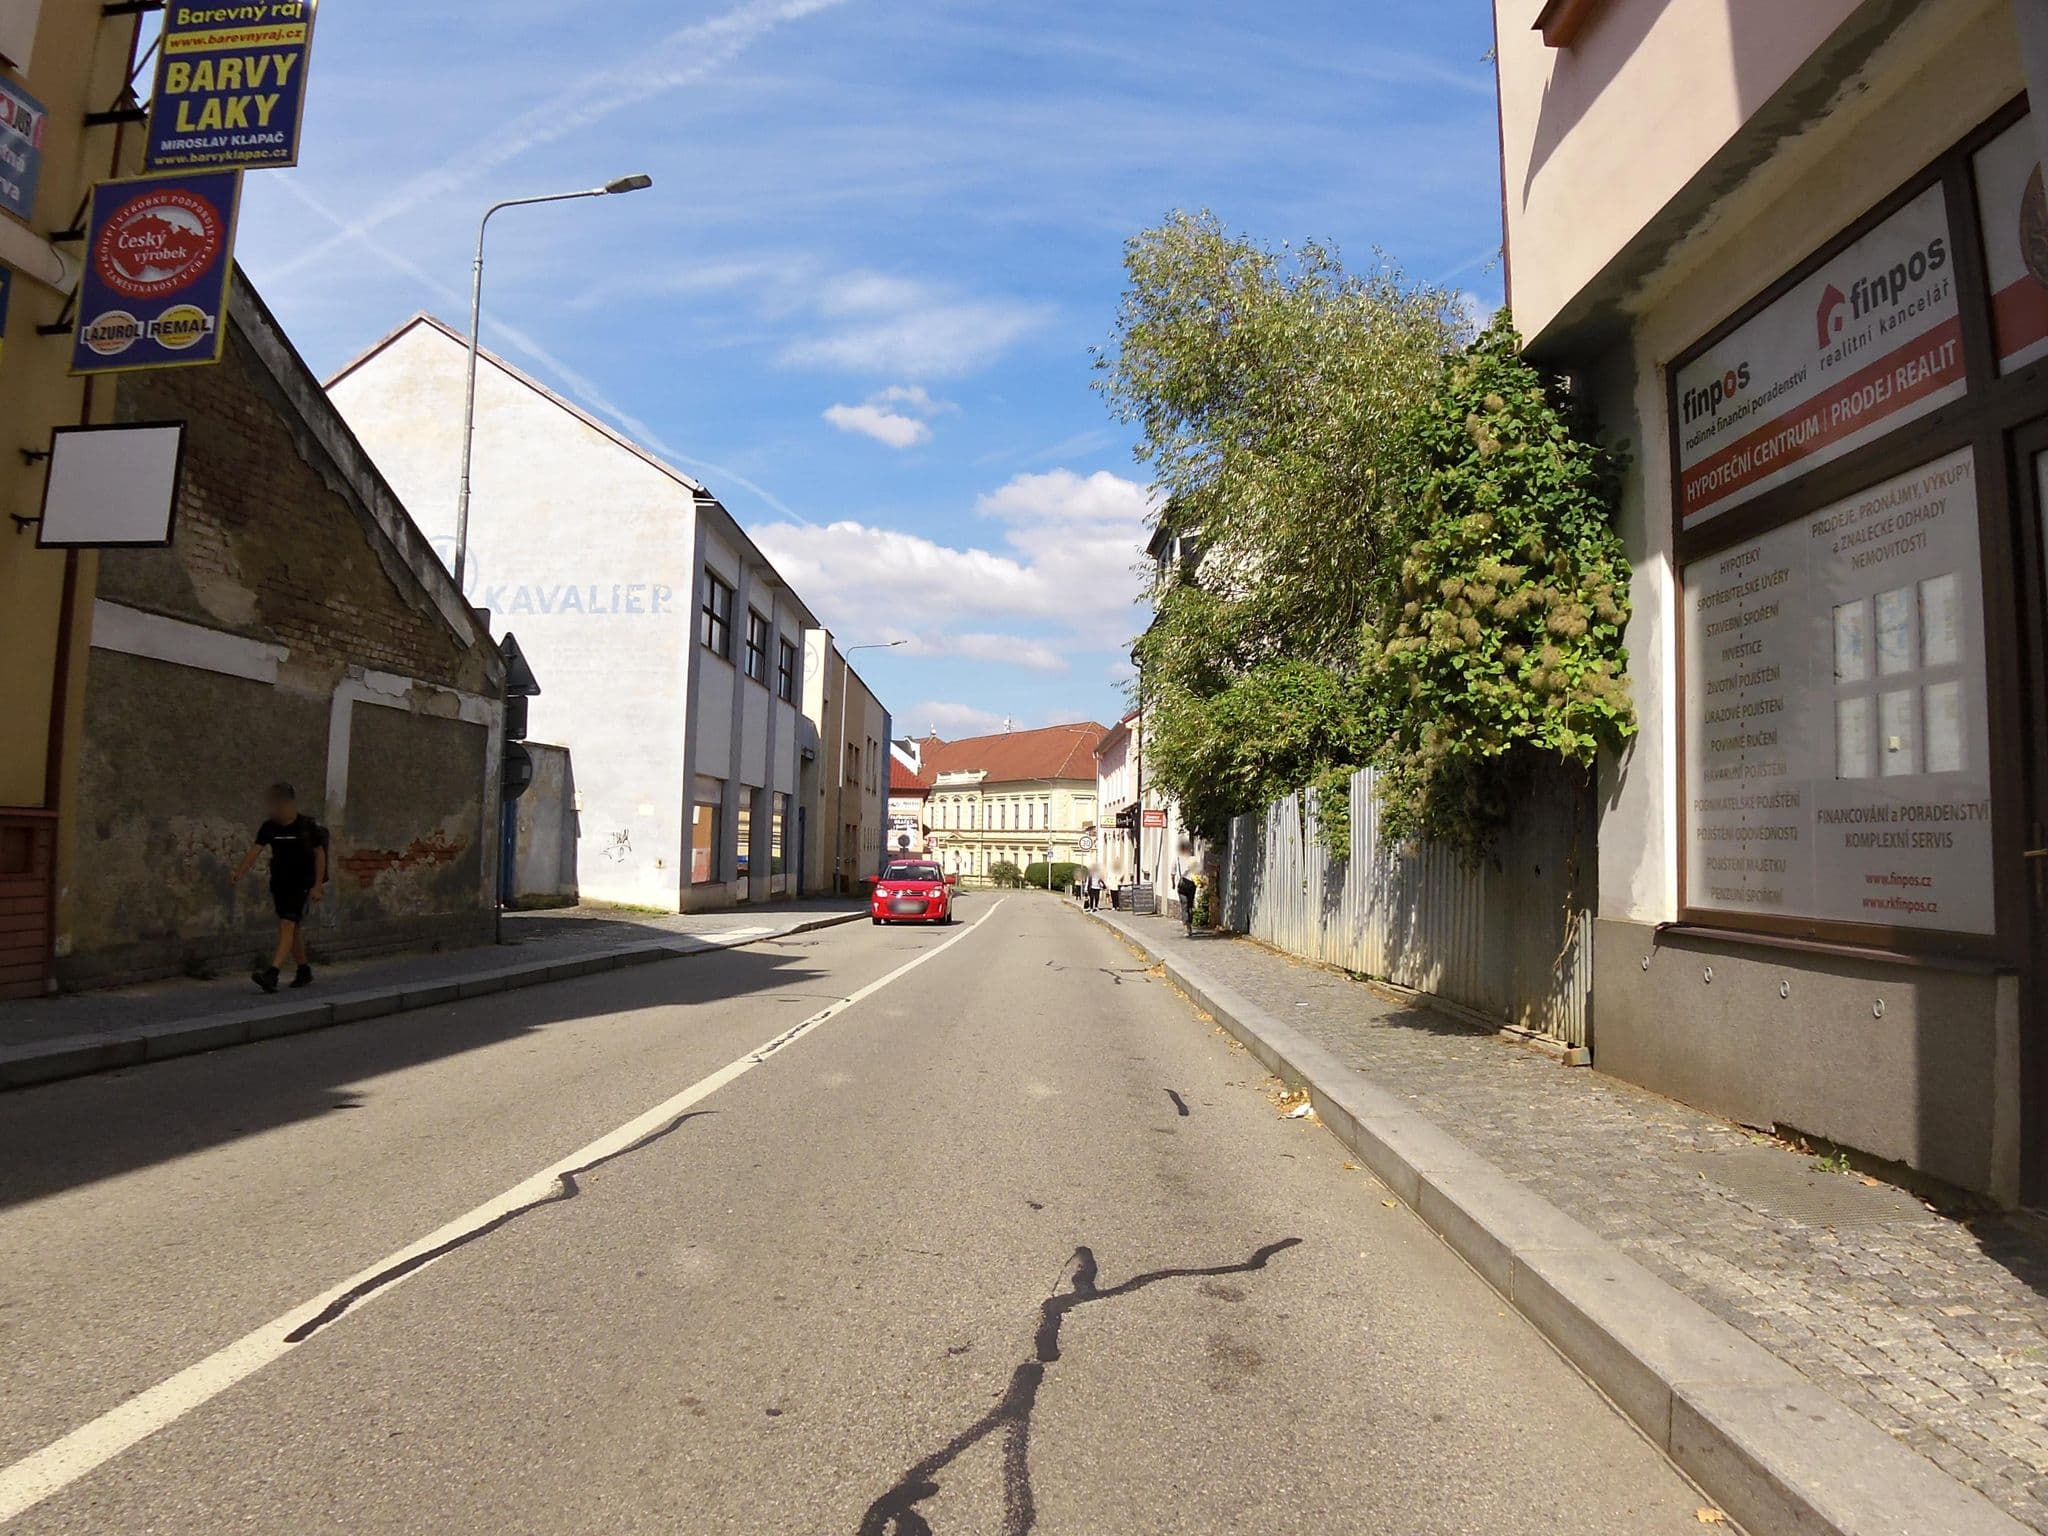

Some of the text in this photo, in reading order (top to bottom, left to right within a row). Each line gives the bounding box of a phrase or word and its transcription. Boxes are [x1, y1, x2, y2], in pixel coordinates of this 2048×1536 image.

[177, 0, 268, 25] Barevný
[170, 29, 303, 48] www.barevnyraj.cz
[165, 52, 298, 94] BARVY
[176, 93, 280, 132] LAKY
[161, 131, 284, 151] MIROSLAV KLAPAČ
[155, 149, 288, 165] www.barvyklapac.cz
[118, 229, 167, 251] Český
[133, 246, 187, 264] výrobek
[1850, 238, 1946, 320] finpos
[84, 318, 211, 342] LAZUROL REMAL
[1820, 278, 1949, 371] realitní kancelář
[1683, 361, 1750, 424] finpos
[1716, 403, 1750, 432] finanční
[1751, 364, 1807, 414] poradenství
[1687, 338, 1956, 502] HYPOTEČNÍ CENTRUM PRODEJ REALIT
[1923, 461, 1972, 494] VÝKUPY
[1832, 542, 1839, 553] a
[1896, 498, 1947, 531] ODHADY
[485, 584, 673, 615] KAVALIER
[1722, 640, 1762, 661] INVESTICE
[1818, 800, 1990, 824] FINANCOVÁNÍ a PORADENSTVÍ
[1845, 829, 1954, 848] KOMPLEXNÍ SERVIS
[1865, 872, 1933, 889] www.finpos.cz
